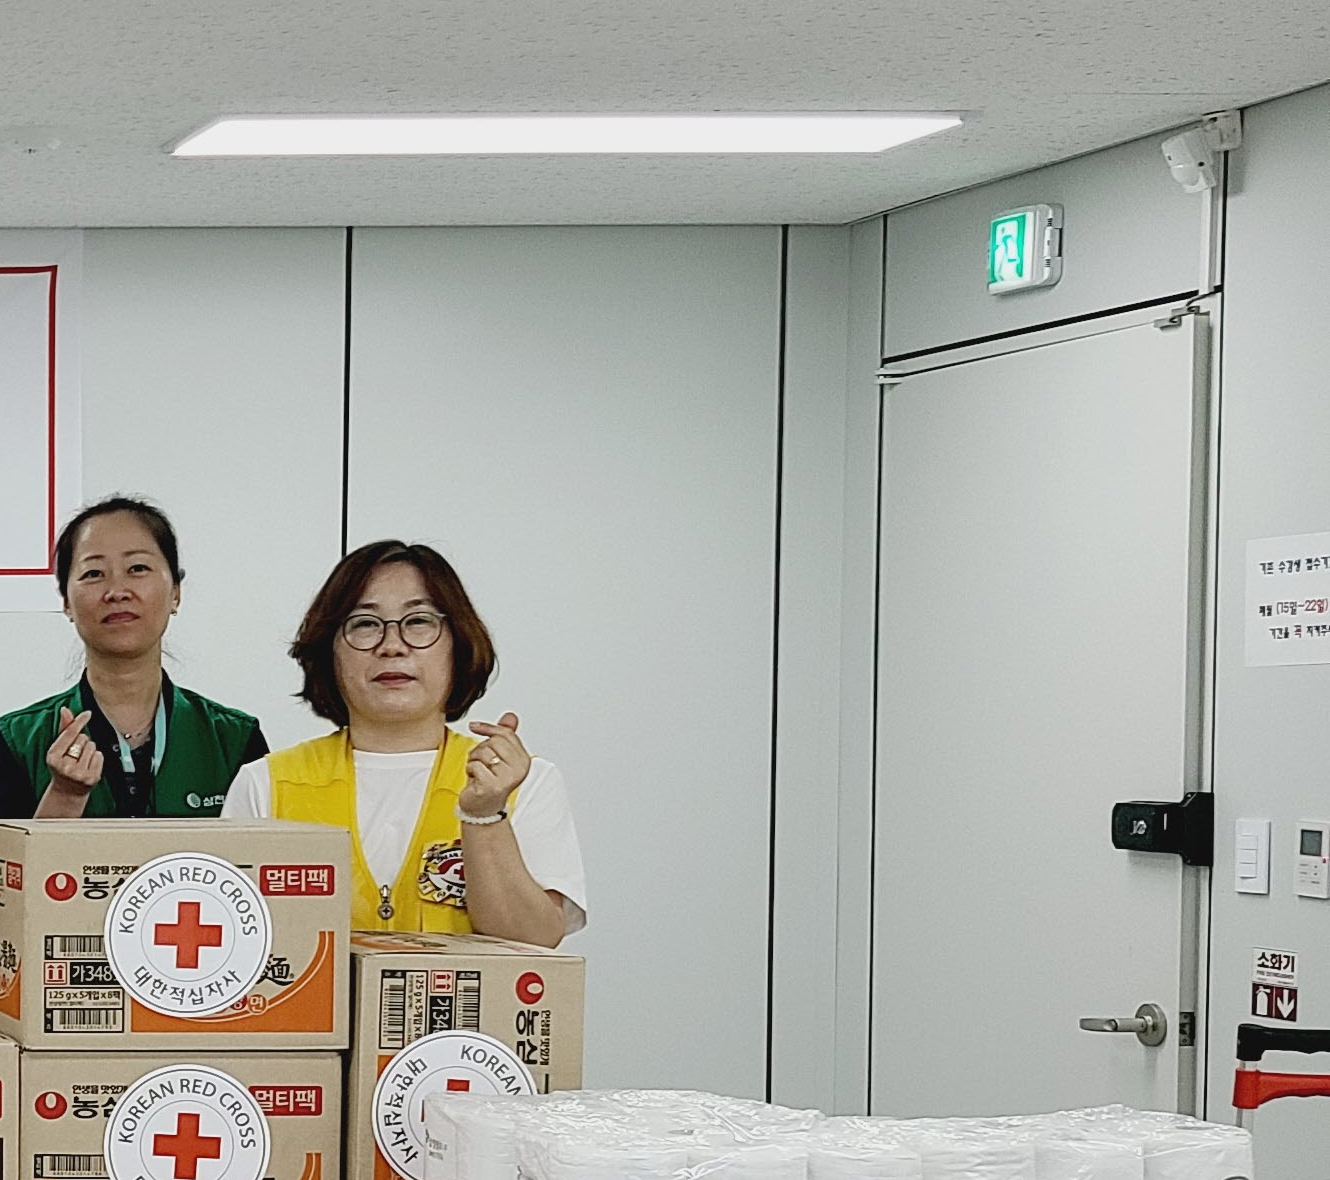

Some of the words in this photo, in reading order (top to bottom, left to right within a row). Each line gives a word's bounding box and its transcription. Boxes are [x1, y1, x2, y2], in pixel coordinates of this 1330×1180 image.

[266, 868, 330, 893] 멀티팩
[118, 869, 175, 934] KOREAN
[179, 866, 217, 885] RED
[219, 879, 258, 936] CROSS
[1257, 952, 1296, 973] 소화기
[133, 965, 242, 1006] 대한적십자사
